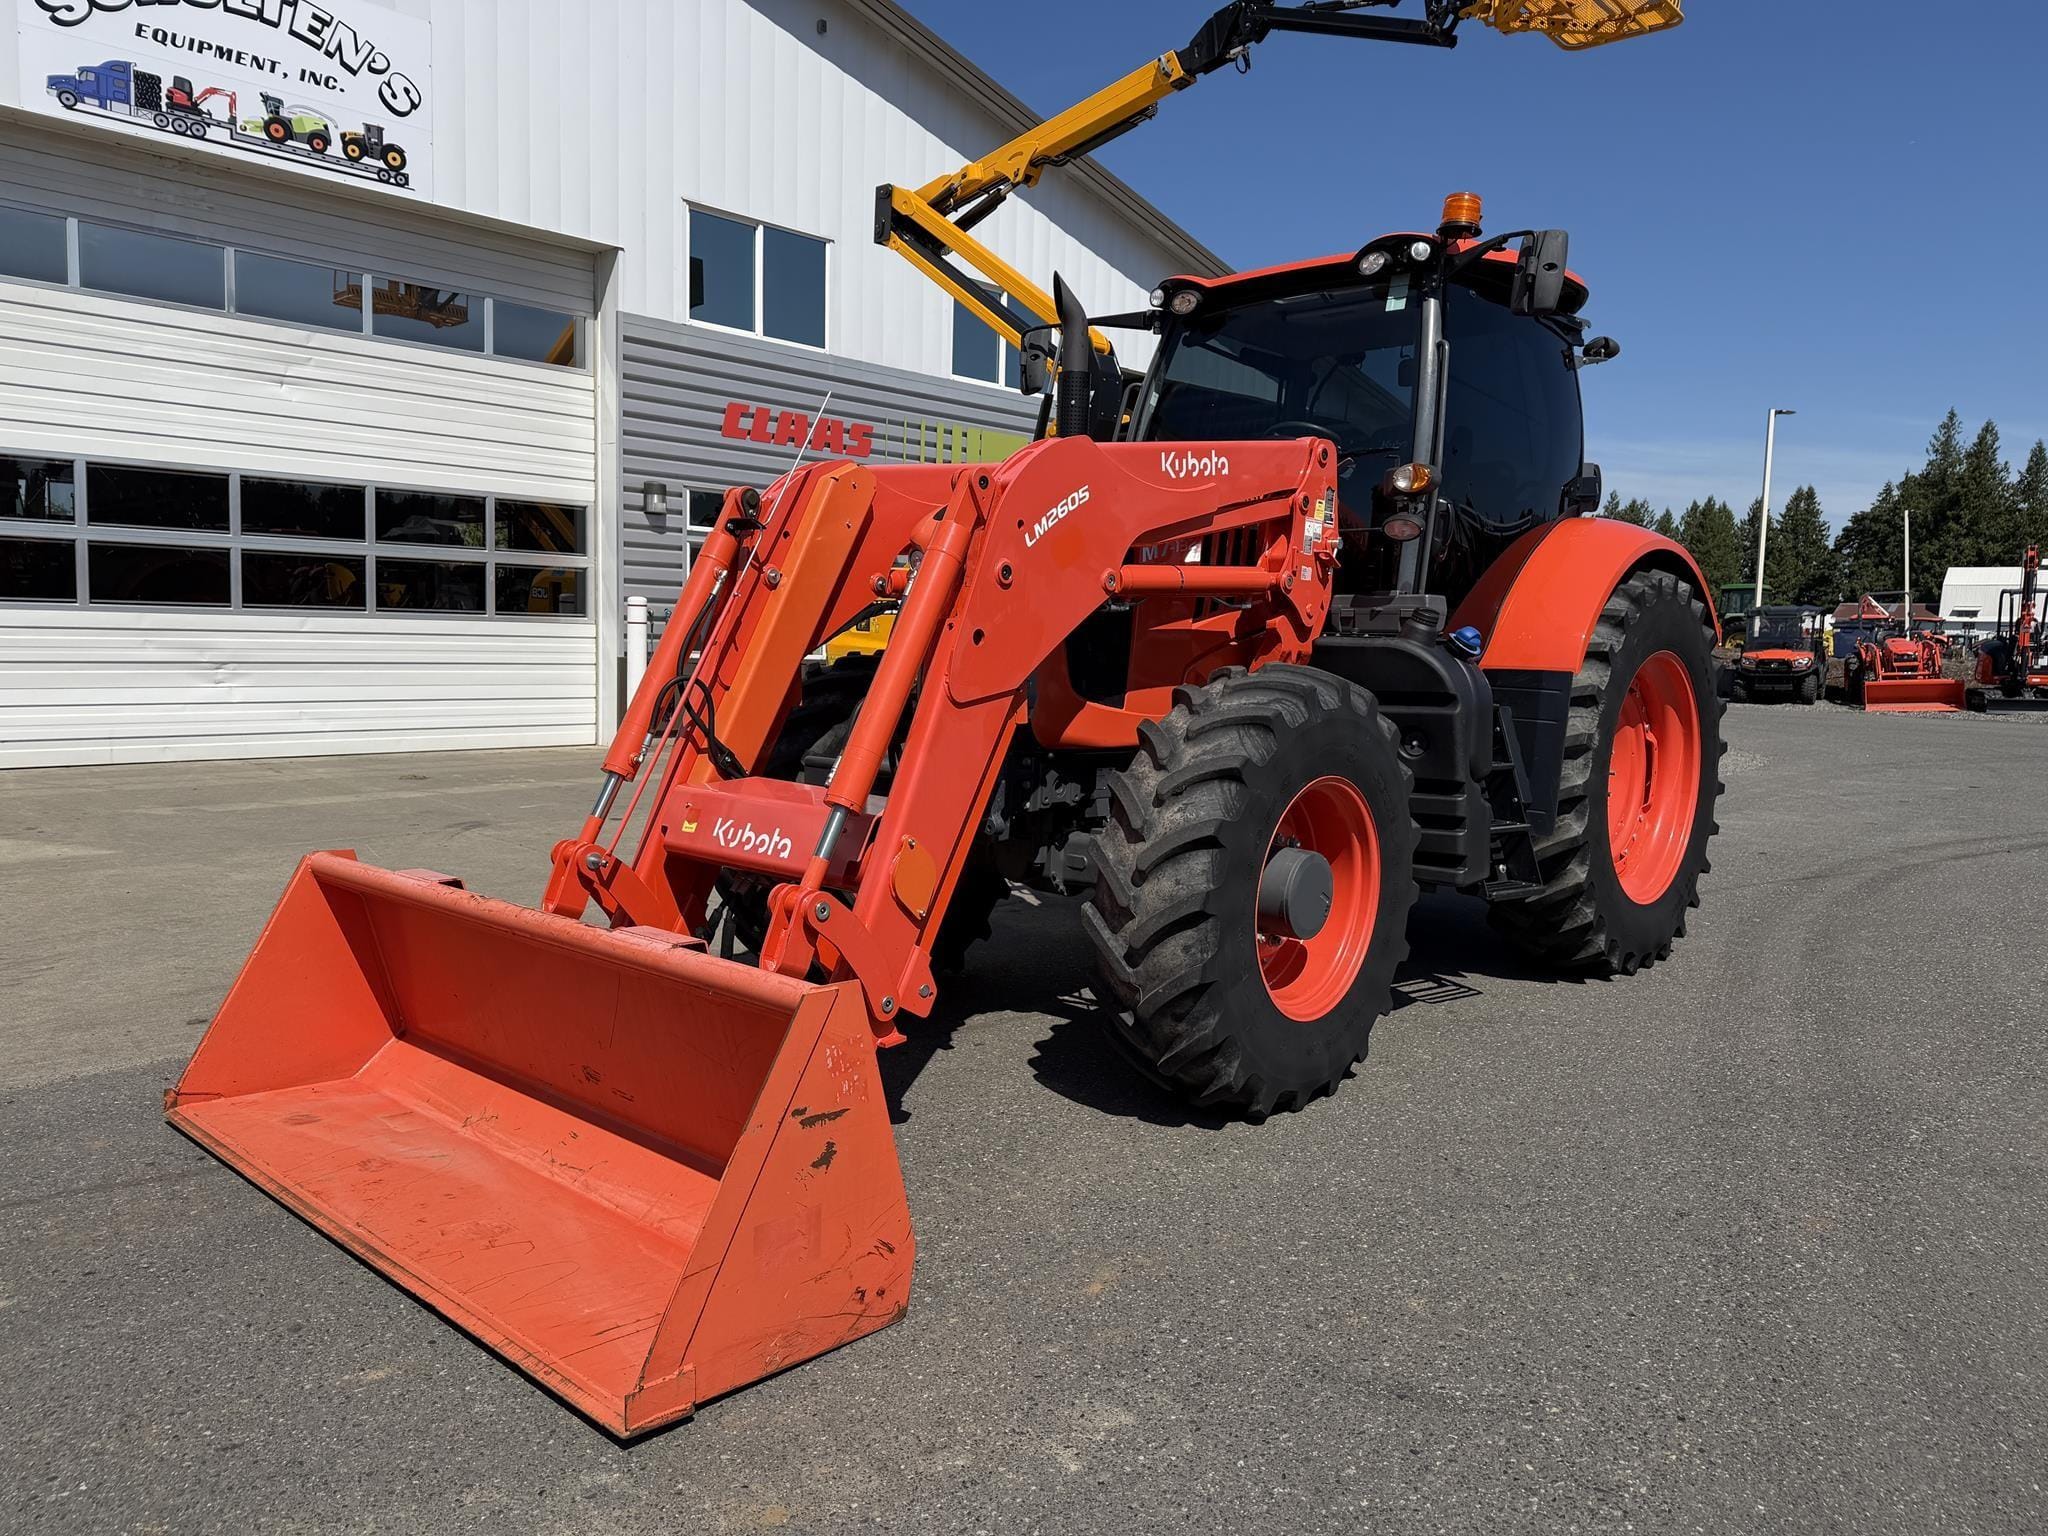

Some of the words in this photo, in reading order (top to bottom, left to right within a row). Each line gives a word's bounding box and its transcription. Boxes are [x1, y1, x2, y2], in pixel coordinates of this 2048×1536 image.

[134, 22, 290, 80] EQUIPMENT,
[299, 68, 346, 93] INC.
[721, 402, 874, 458] CLAAS
[1161, 450, 1229, 478] Kubota
[1024, 484, 1091, 548] LM2605
[712, 817, 792, 859] Kubota
